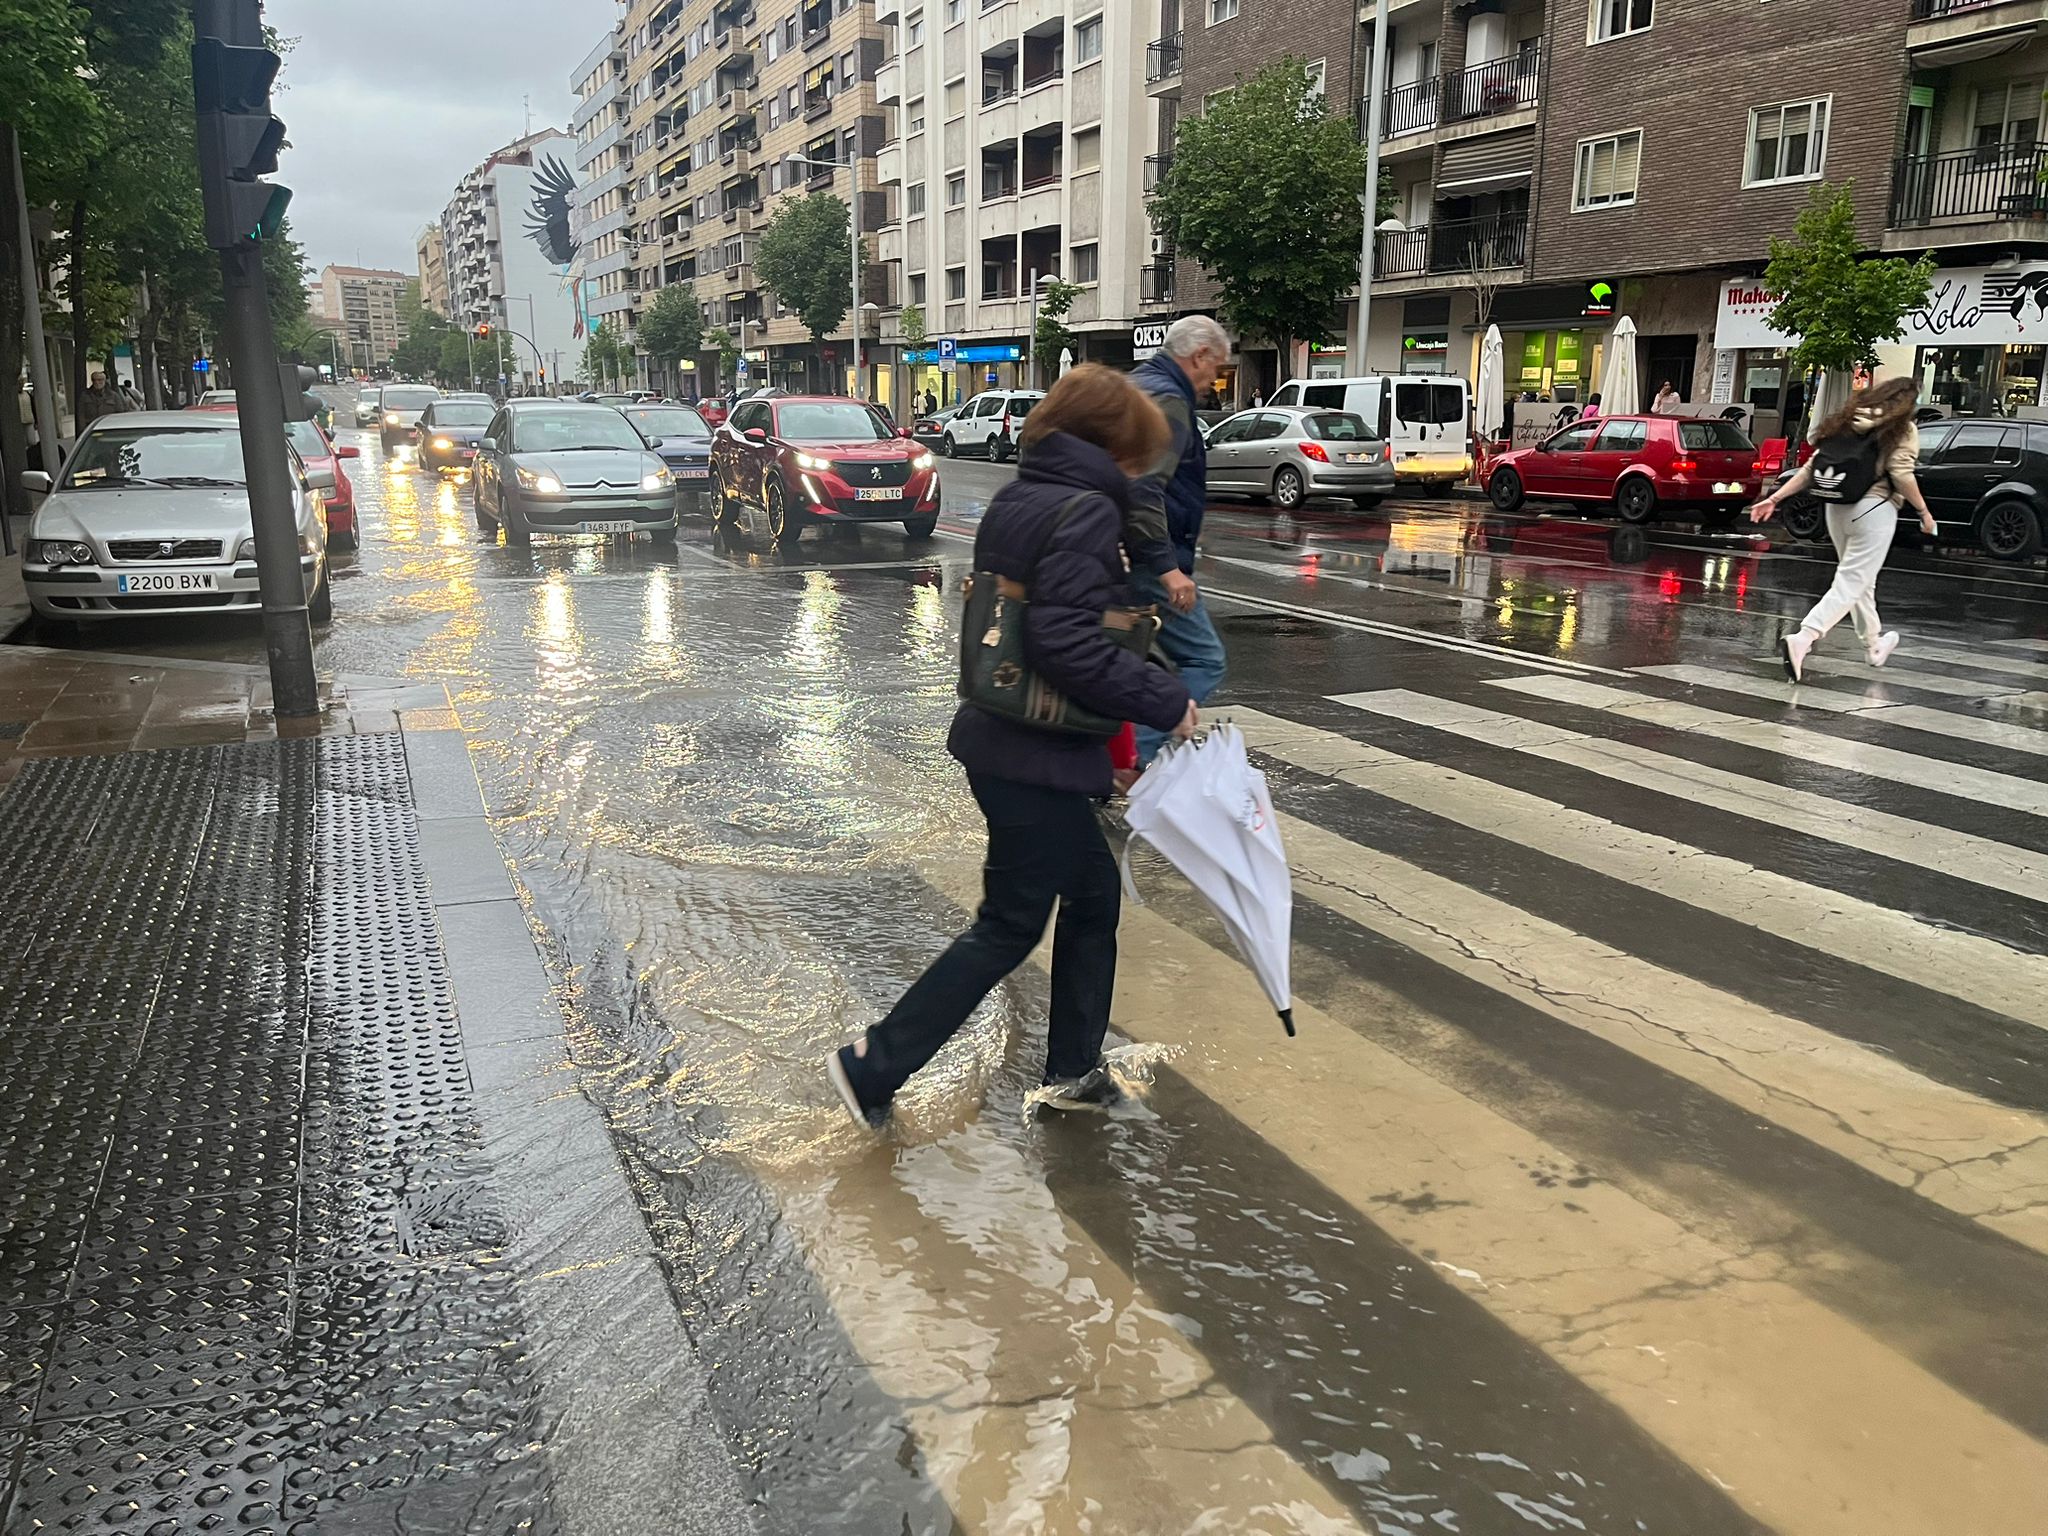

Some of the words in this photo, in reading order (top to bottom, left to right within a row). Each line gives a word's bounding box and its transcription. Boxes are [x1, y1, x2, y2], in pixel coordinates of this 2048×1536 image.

[1911, 279, 1984, 335] Lola
[941, 340, 953, 356] P
[738, 359, 746, 372] P
[1540, 423, 1556, 440] Lol
[884, 489, 901, 498] LTC
[587, 523, 609, 532] 3483
[613, 522, 631, 531] FYF
[130, 576, 174, 590] 2200
[180, 574, 212, 589] BXW
